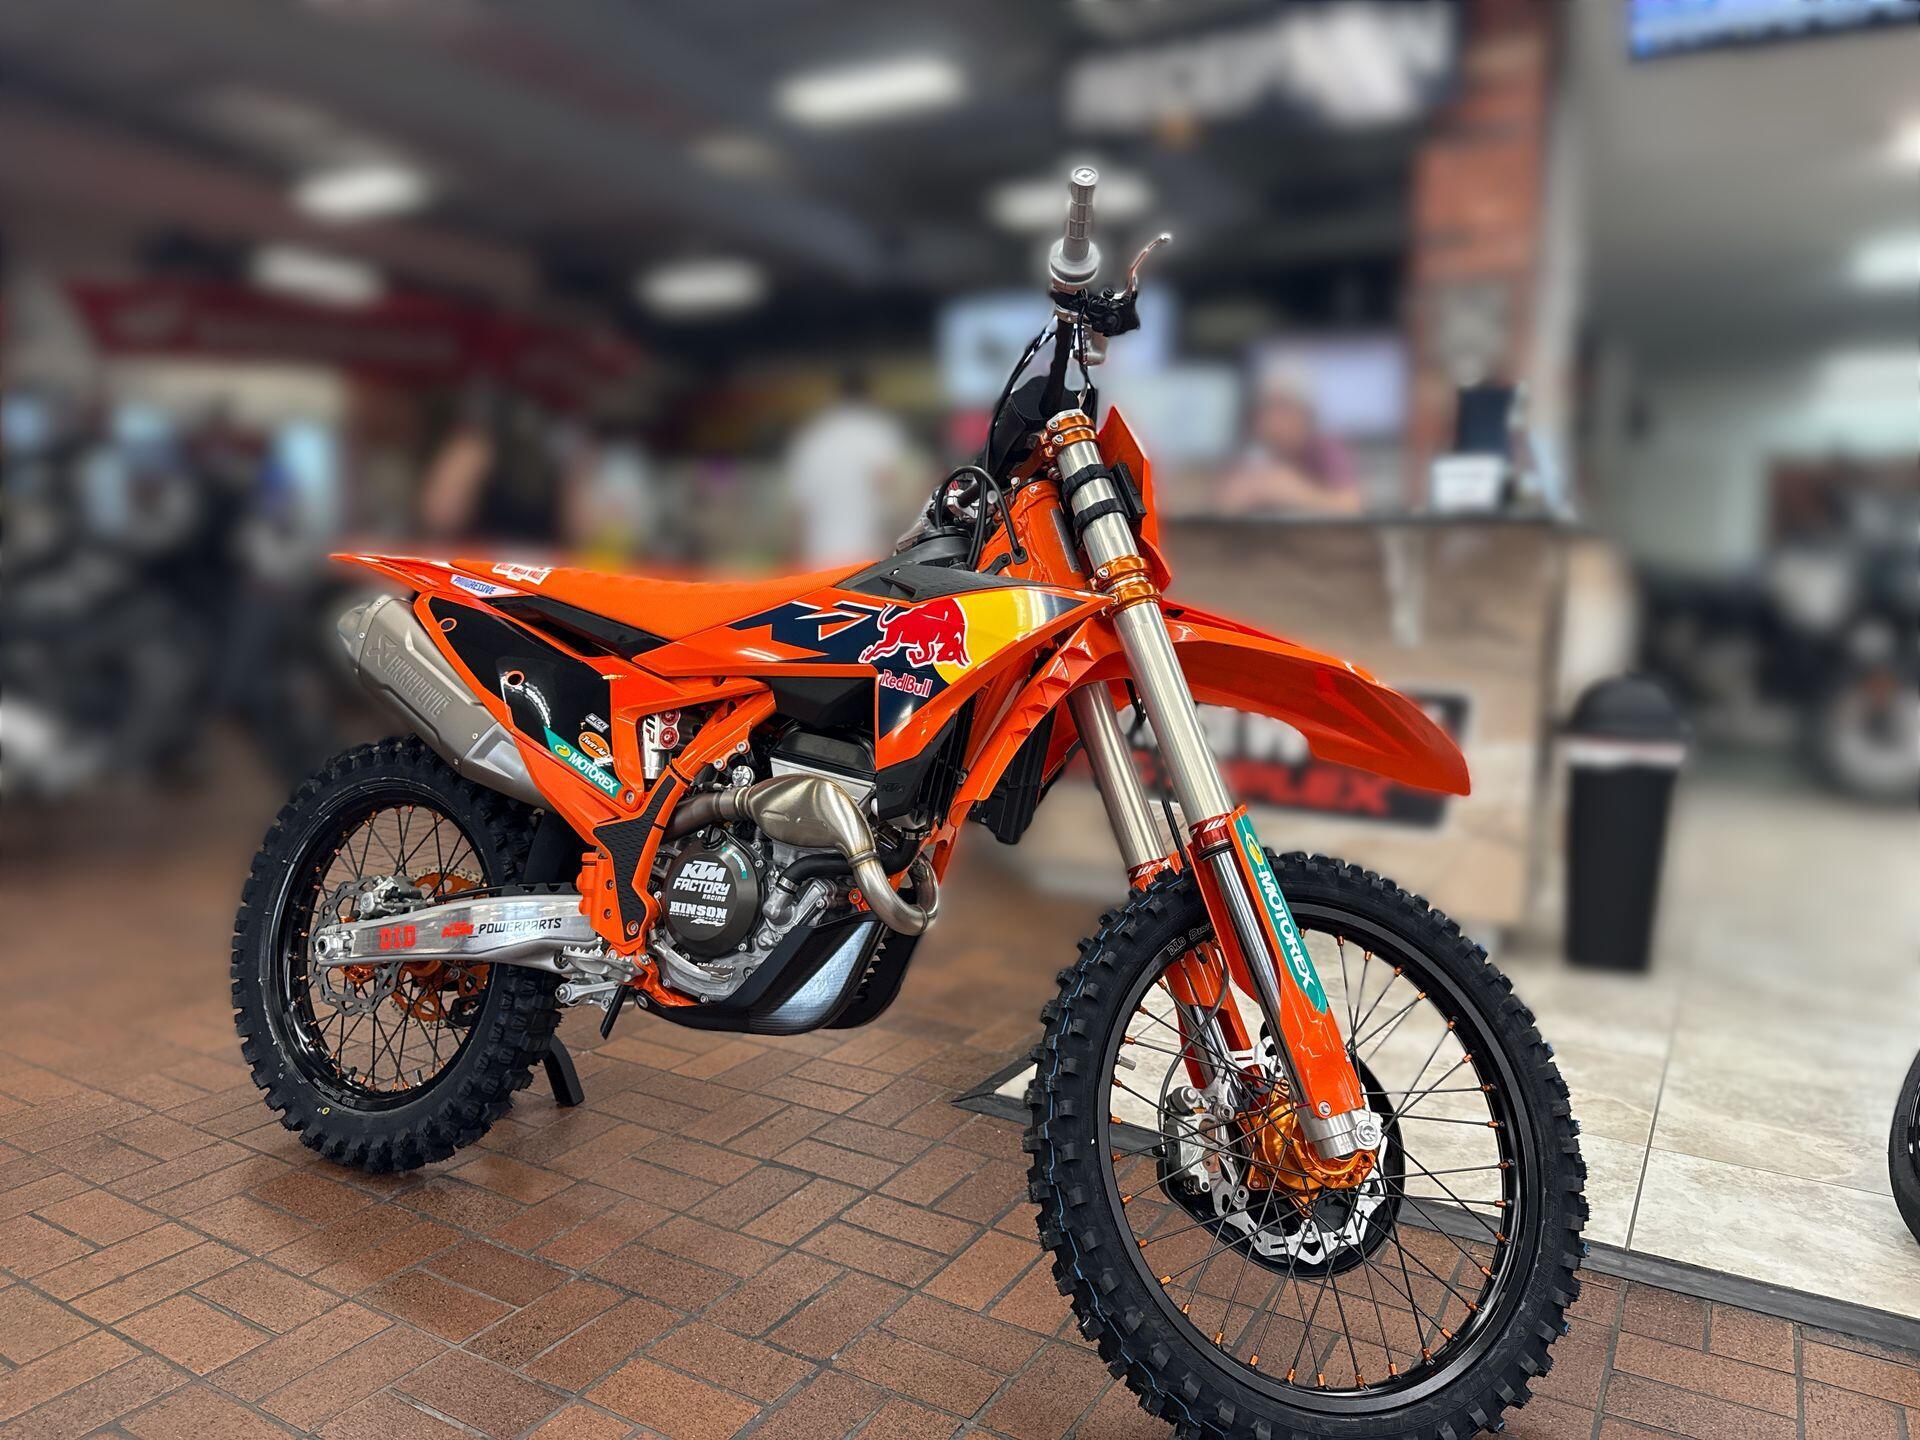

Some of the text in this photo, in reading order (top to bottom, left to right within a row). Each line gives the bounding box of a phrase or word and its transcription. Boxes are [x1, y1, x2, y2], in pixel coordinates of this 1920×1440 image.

[567, 751, 618, 794] MOTOREX
[680, 859, 727, 882] KTM
[672, 877, 731, 896] FACTORY
[669, 901, 728, 919] HINSON
[1257, 870, 1315, 988] MOTOREX
